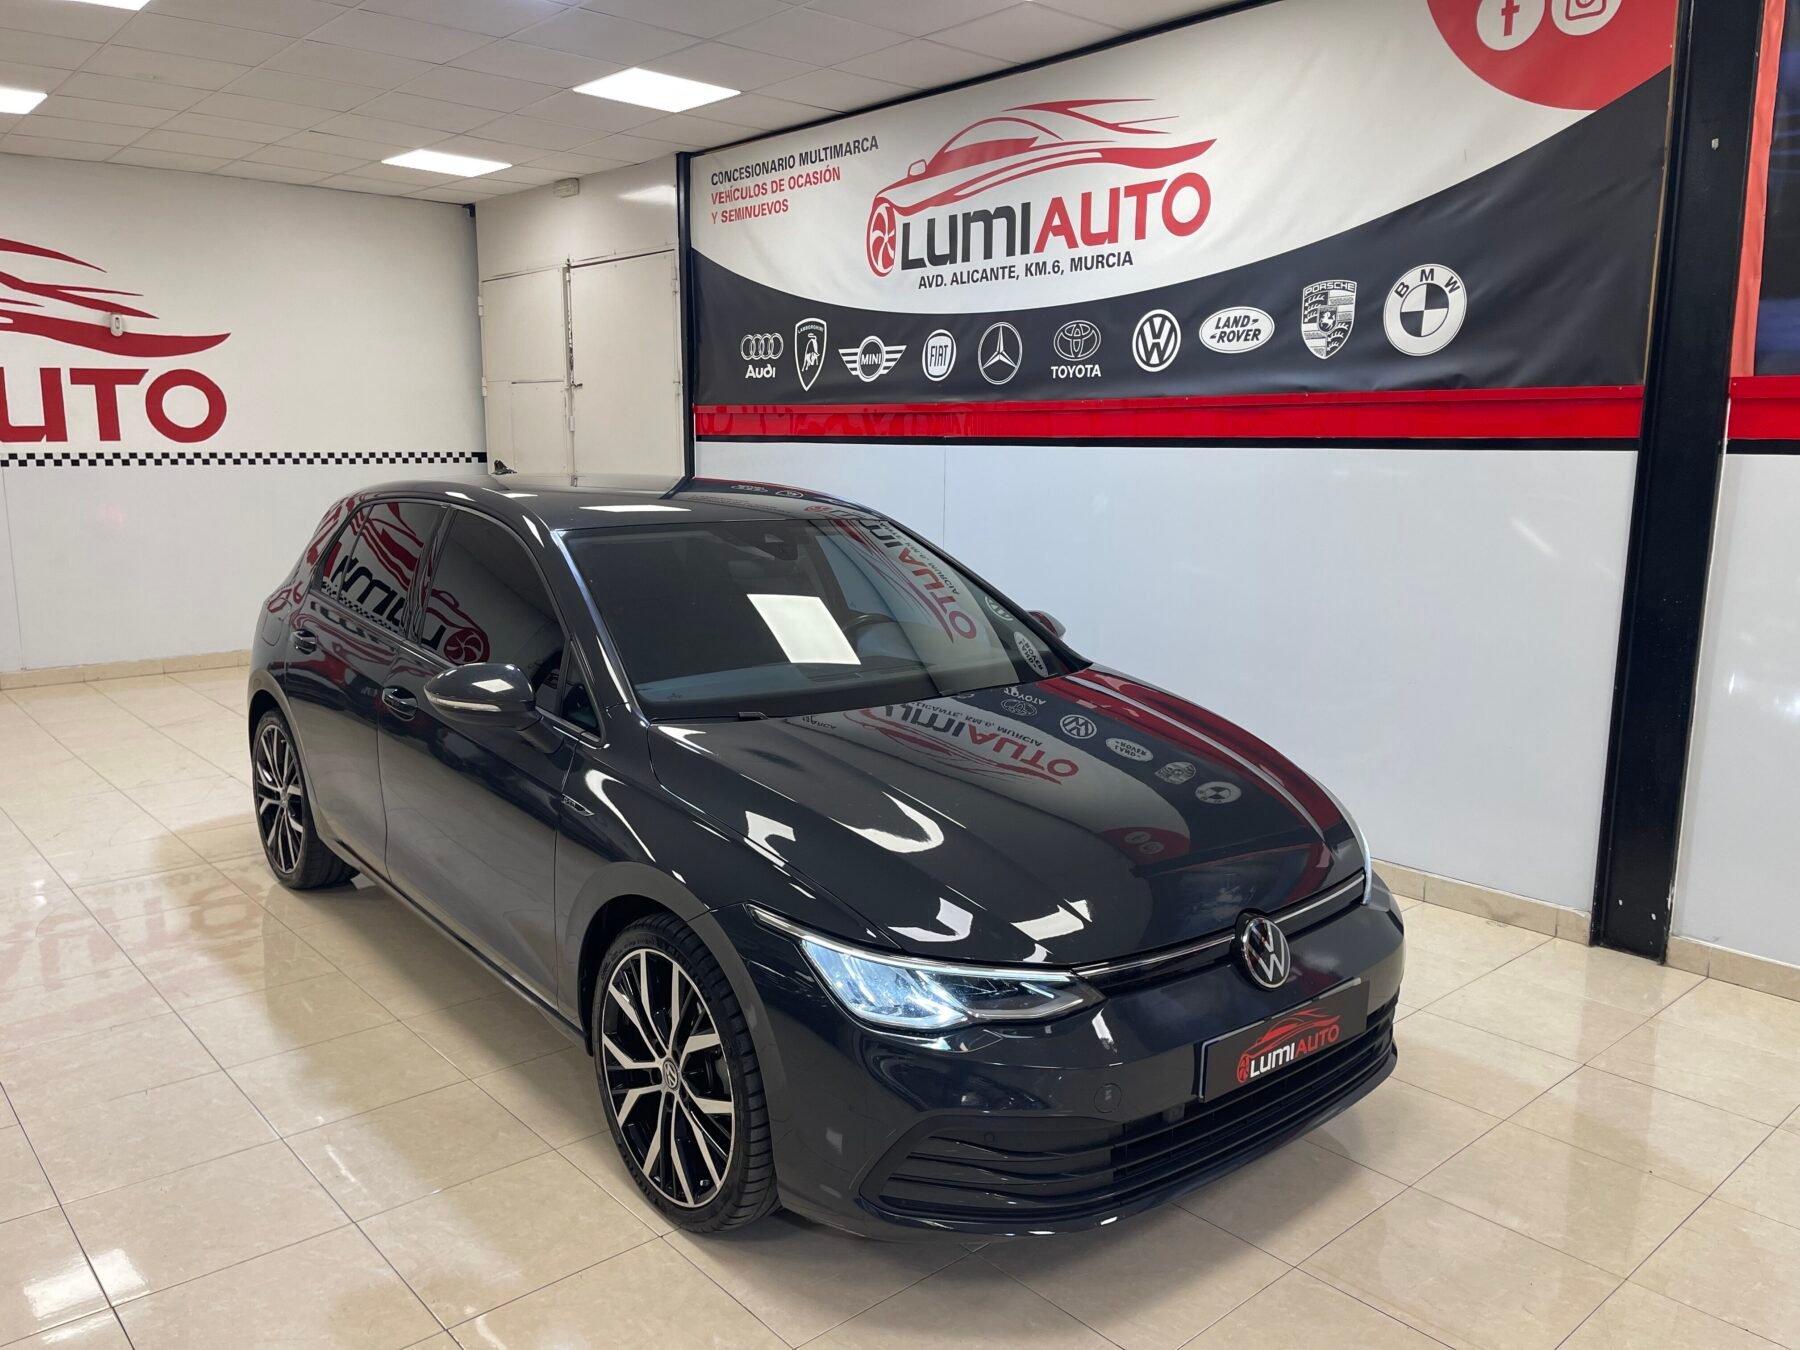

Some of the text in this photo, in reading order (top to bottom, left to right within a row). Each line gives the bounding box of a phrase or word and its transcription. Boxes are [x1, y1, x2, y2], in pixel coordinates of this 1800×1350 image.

[711, 135, 879, 186] CONCESIONARIO MULTIMARCA
[711, 165, 841, 205] VEHÍCULOS DE OCASIÓN
[711, 199, 789, 224] Y SEMINUEVOS
[918, 251, 1134, 290] AVD. ALICANTE, KM.6, MURCIA
[1304, 282, 1355, 296] PORSCHE
[1394, 268, 1460, 298] BMW
[1217, 328, 1262, 344] ROVER
[860, 353, 882, 366] MINI
[930, 344, 949, 368] FIAT
[745, 364, 776, 379] Audi
[1050, 364, 1101, 380] TOYOTA
